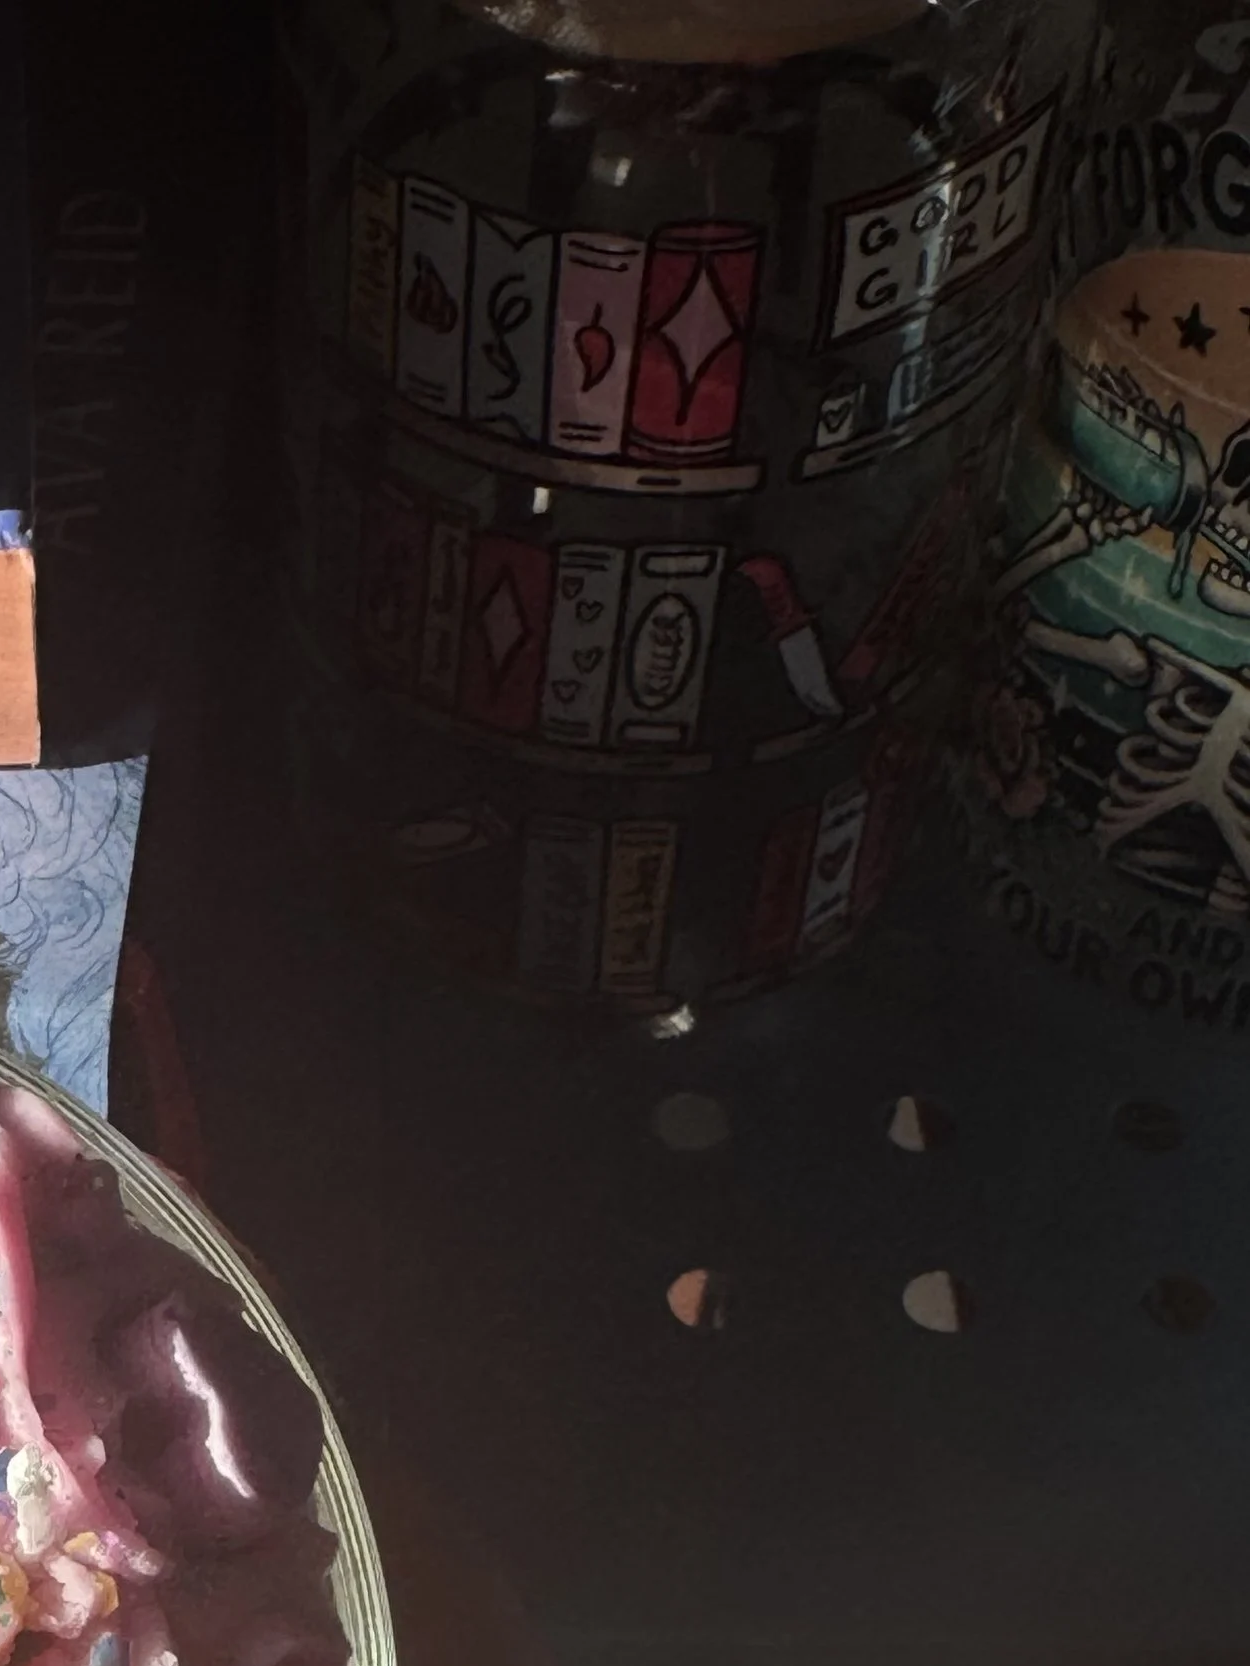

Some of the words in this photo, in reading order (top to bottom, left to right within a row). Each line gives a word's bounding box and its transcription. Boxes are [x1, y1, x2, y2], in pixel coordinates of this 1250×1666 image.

[855, 203, 1018, 310] GIRL
[858, 143, 1028, 258] GOOD
[36, 189, 148, 355] REID
[35, 398, 114, 553] AVA
